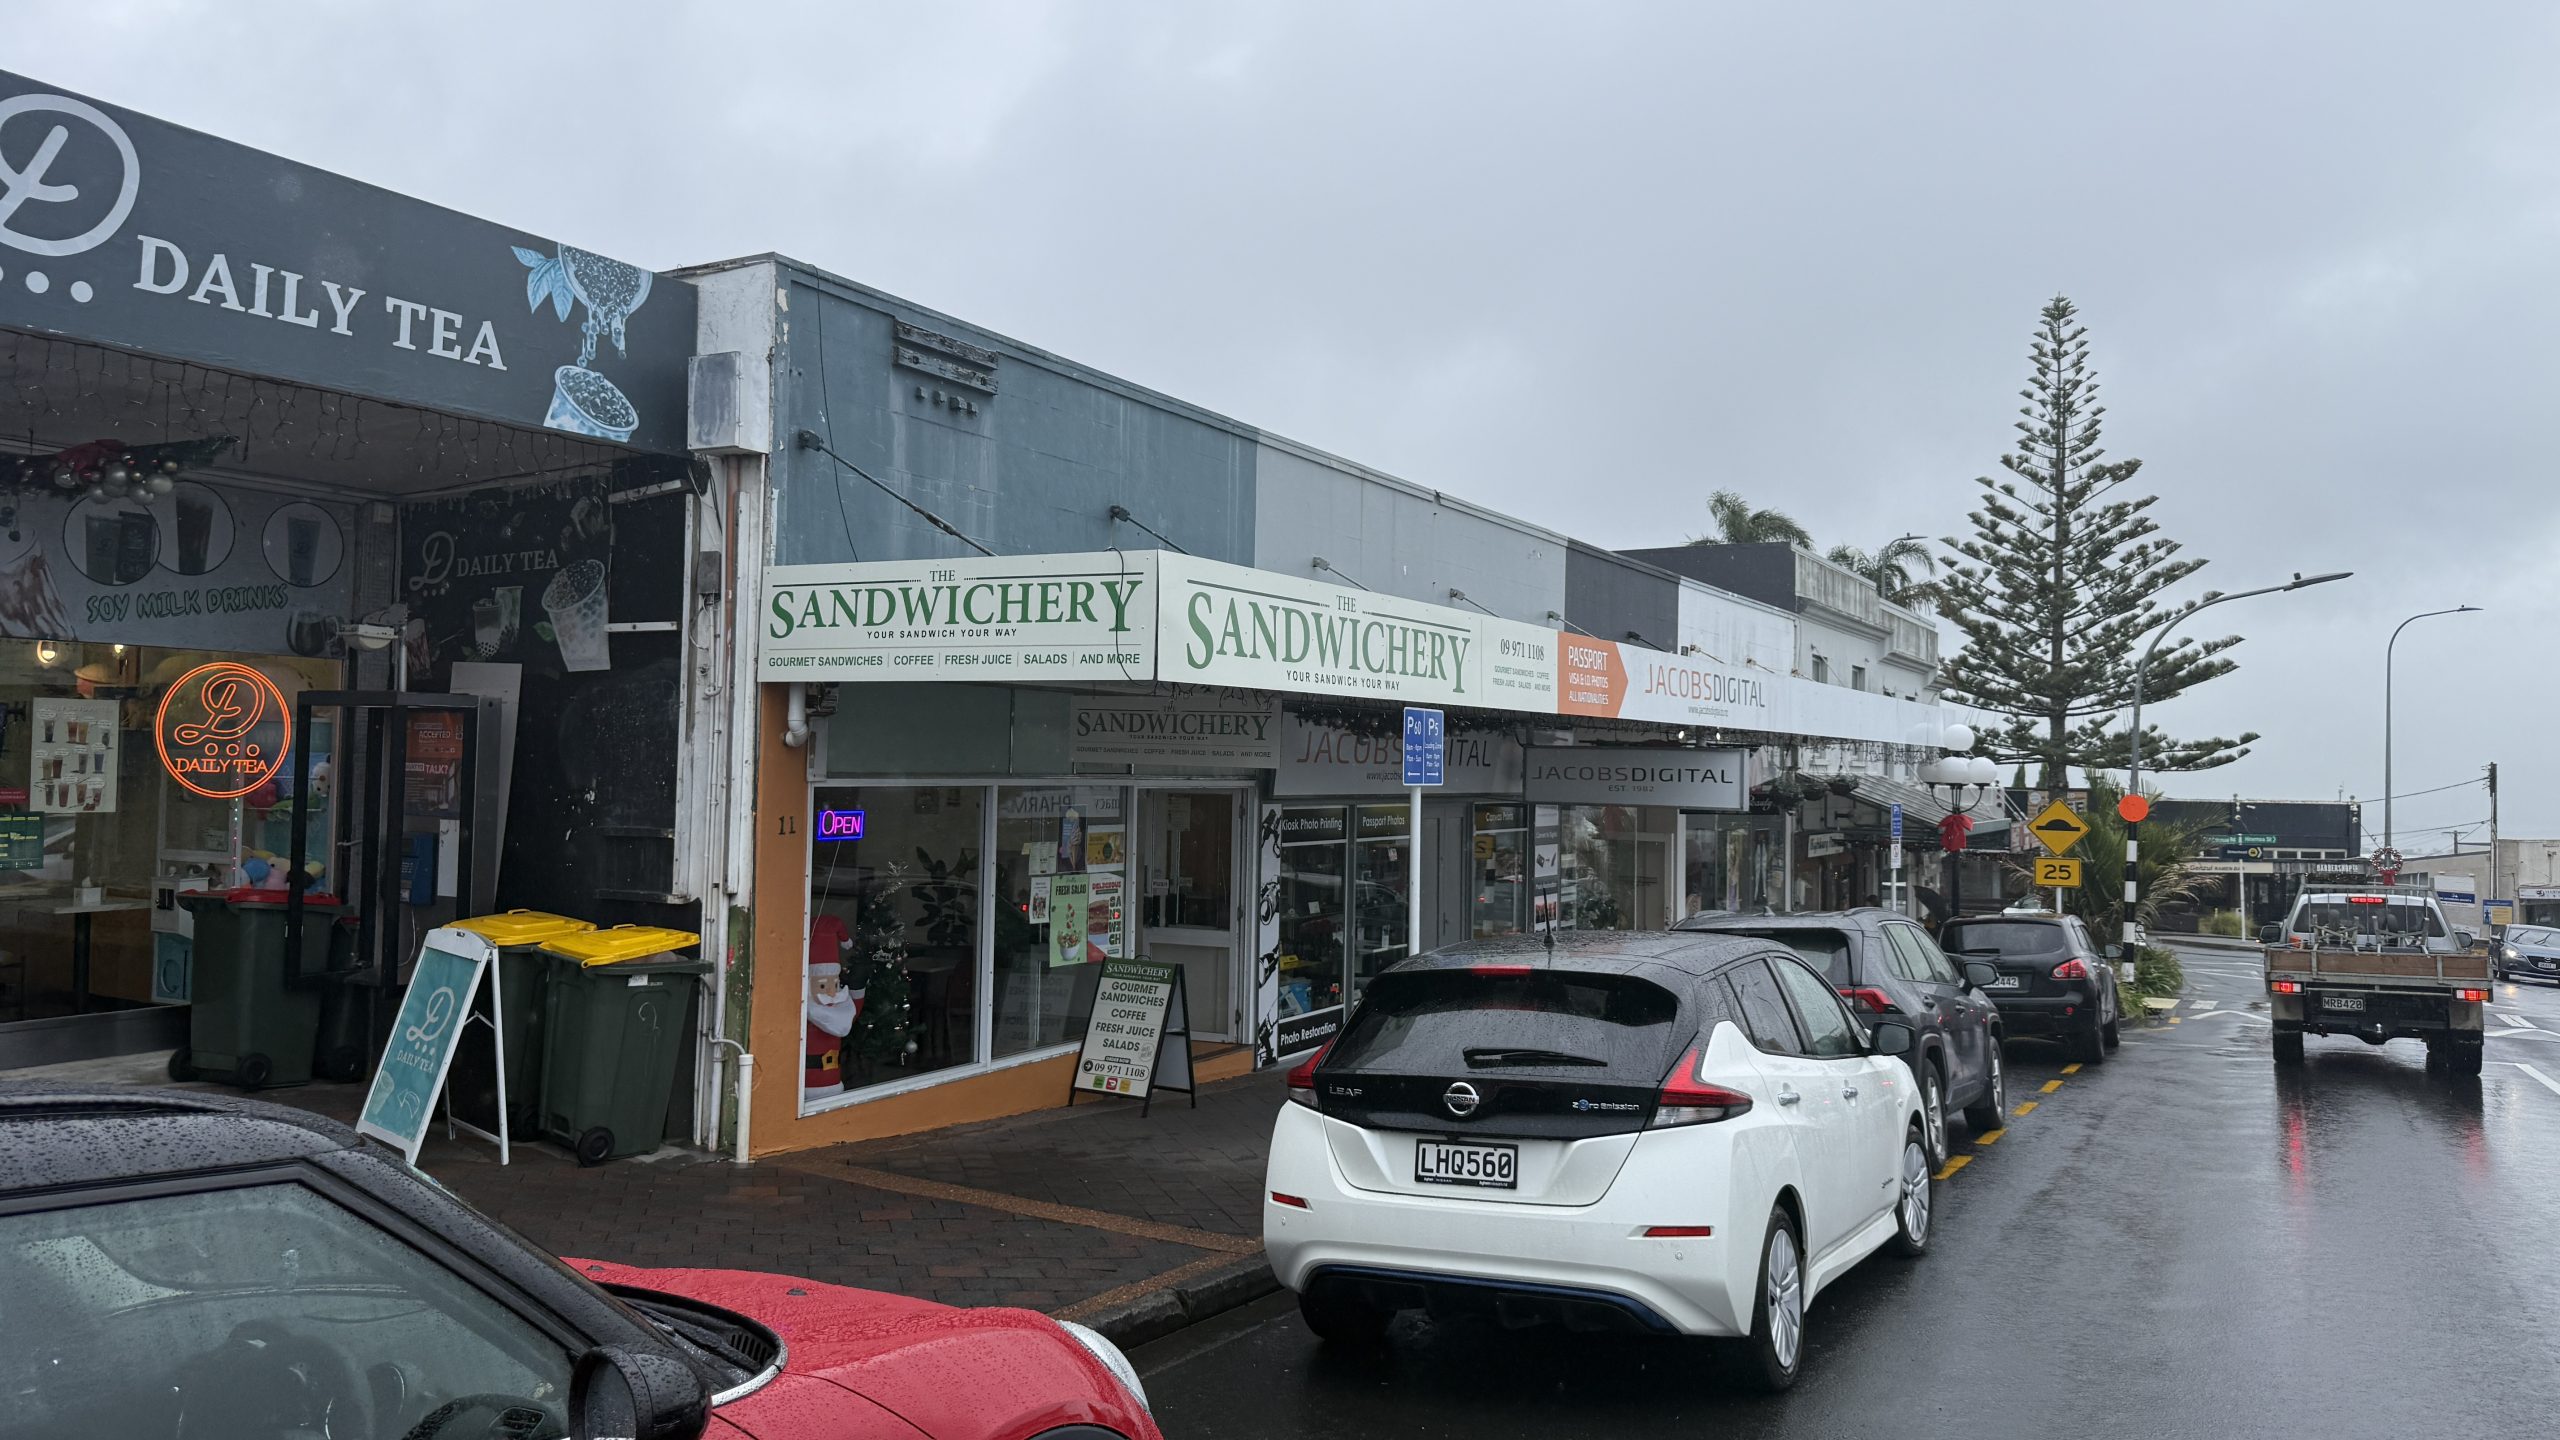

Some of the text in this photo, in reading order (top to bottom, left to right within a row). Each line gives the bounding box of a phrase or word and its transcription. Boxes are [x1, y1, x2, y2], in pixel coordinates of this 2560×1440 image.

[133, 235, 507, 372] DAILY TEA
[456, 550, 559, 578] DAILY TEA
[930, 569, 956, 583] THE
[87, 584, 288, 624] SOY MILK DRINKS
[769, 580, 1144, 639] SANDWICHERY
[1336, 595, 1357, 613] THE
[867, 628, 1018, 640] YOUR SANDWICH YOUR WAY
[1186, 591, 1471, 694] SANDWICHERY
[1500, 638, 1545, 661] 09 971 1108
[768, 653, 1141, 668] GOURMET SANDWICHES COFFEE FRESH JUICE SALADS AND MORE
[1568, 645, 1608, 671] PASSPORT
[1286, 669, 1400, 691] YOUR SANDWICH YOUR WAY
[1568, 672, 1579, 685] VISA
[1591, 675, 1609, 689] PHOTOS
[1645, 664, 1765, 708] JACOBSDIGITAL
[1077, 712, 1272, 741] SANDWICHERY
[1103, 746, 1139, 754] SANDWICHES
[175, 758, 268, 774] DAILY TEA
[425, 764, 449, 775] TALK?
[1532, 766, 1733, 784] JACOBSDIGITAL
[778, 815, 796, 836] 11
[1281, 817, 1342, 831] Kiosk Photo Printing
[1362, 815, 1405, 828] Passport Photos
[2043, 864, 2071, 880] 25
[1055, 884, 1070, 896] FRESH
[1106, 963, 1171, 979] SANDWICHERY
[1112, 981, 1159, 995] GOURMET
[1100, 991, 1164, 1007] SANDWICHES
[2323, 997, 2362, 1011] MRB420
[1111, 1008, 1147, 1021] COFFEE
[1095, 1022, 1155, 1037] FRESH JUICE
[1280, 1022, 1337, 1046] Photo Restoration
[1102, 1038, 1140, 1051] SALADS
[397, 1050, 434, 1074] DAILY TEA
[1094, 1063, 1145, 1078] 09 971 1108
[1329, 1083, 1363, 1097] LEAF
[1447, 1095, 1476, 1103] NISSAN
[1421, 1147, 1512, 1179] LHQ560
